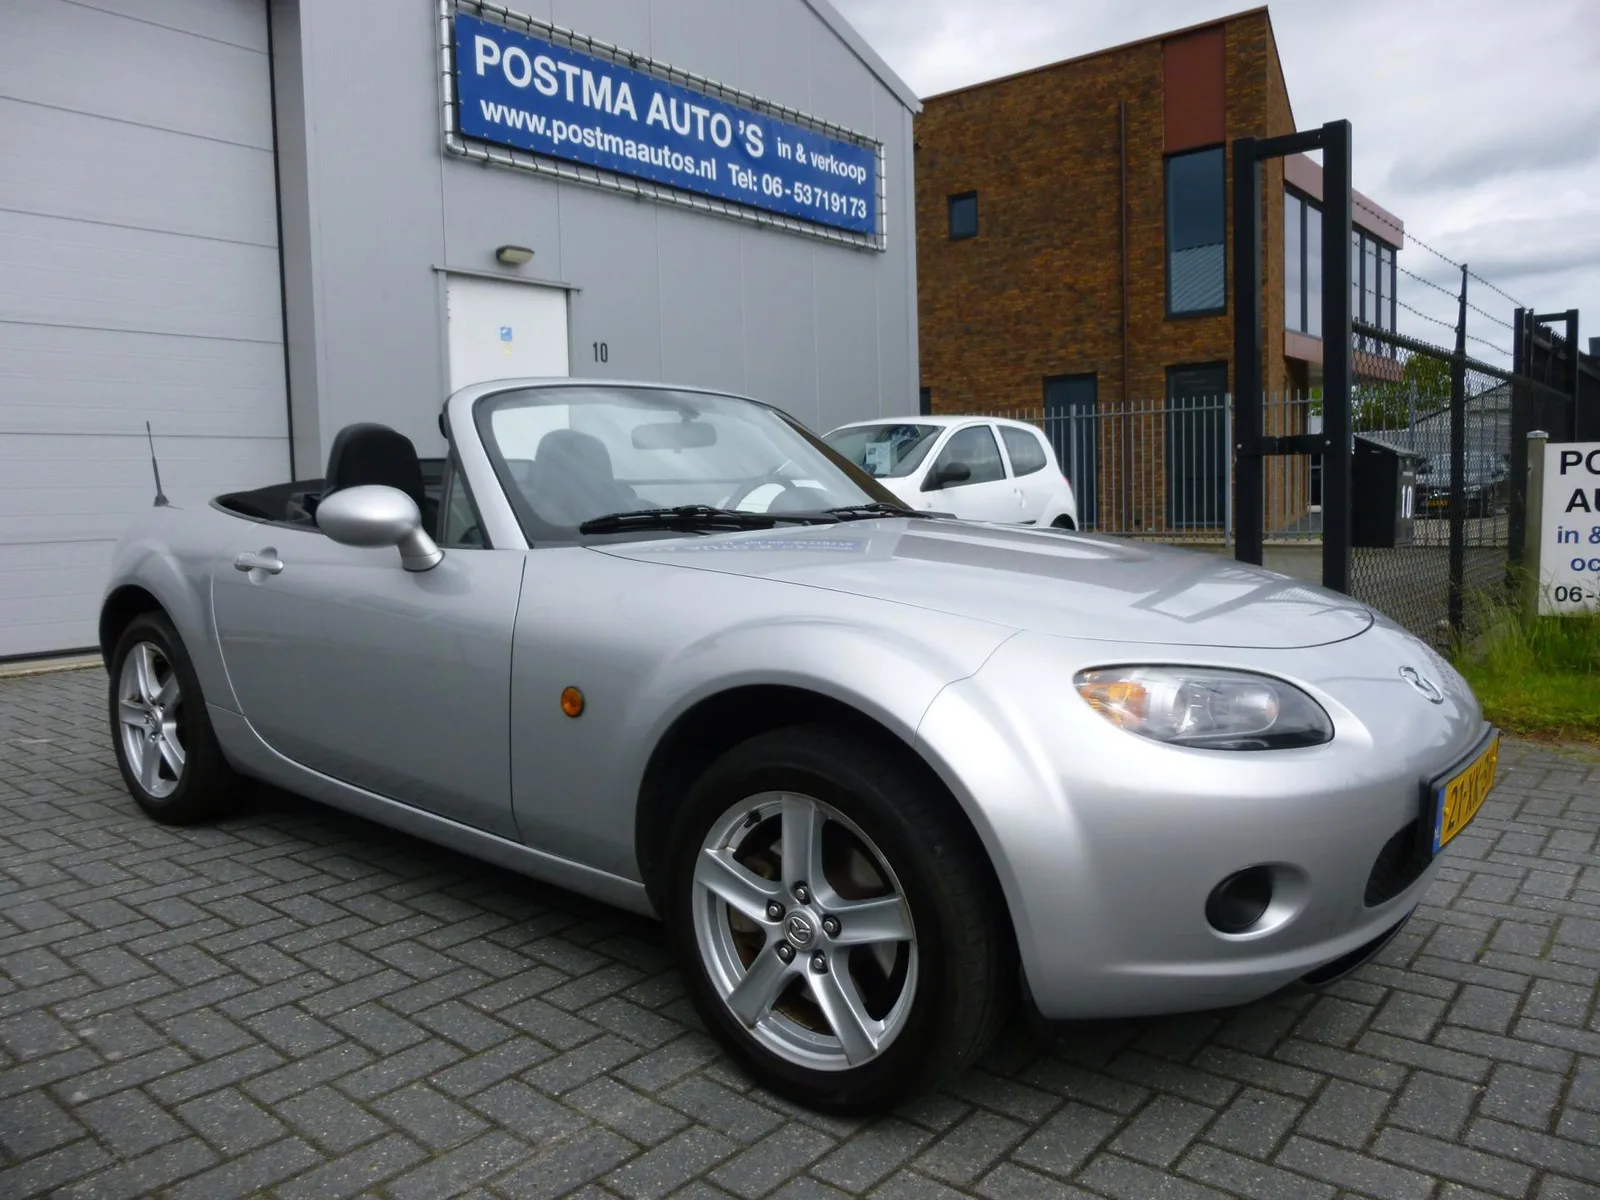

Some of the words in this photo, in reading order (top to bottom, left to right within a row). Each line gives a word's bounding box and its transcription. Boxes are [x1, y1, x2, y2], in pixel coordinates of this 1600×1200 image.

[475, 35, 638, 121] POSTMA
[646, 92, 765, 158] AUTO'S
[480, 99, 717, 181] www.postmaautos.nl
[728, 163, 758, 192] Tel:
[777, 137, 792, 161] in
[796, 143, 807, 165] &
[810, 151, 867, 185] verkoop
[592, 341, 609, 363] 10
[1401, 484, 1413, 519] 10
[1564, 488, 1600, 513] A
[1557, 526, 1579, 544] in
[1588, 525, 1600, 544] &
[1570, 557, 1600, 572] oc
